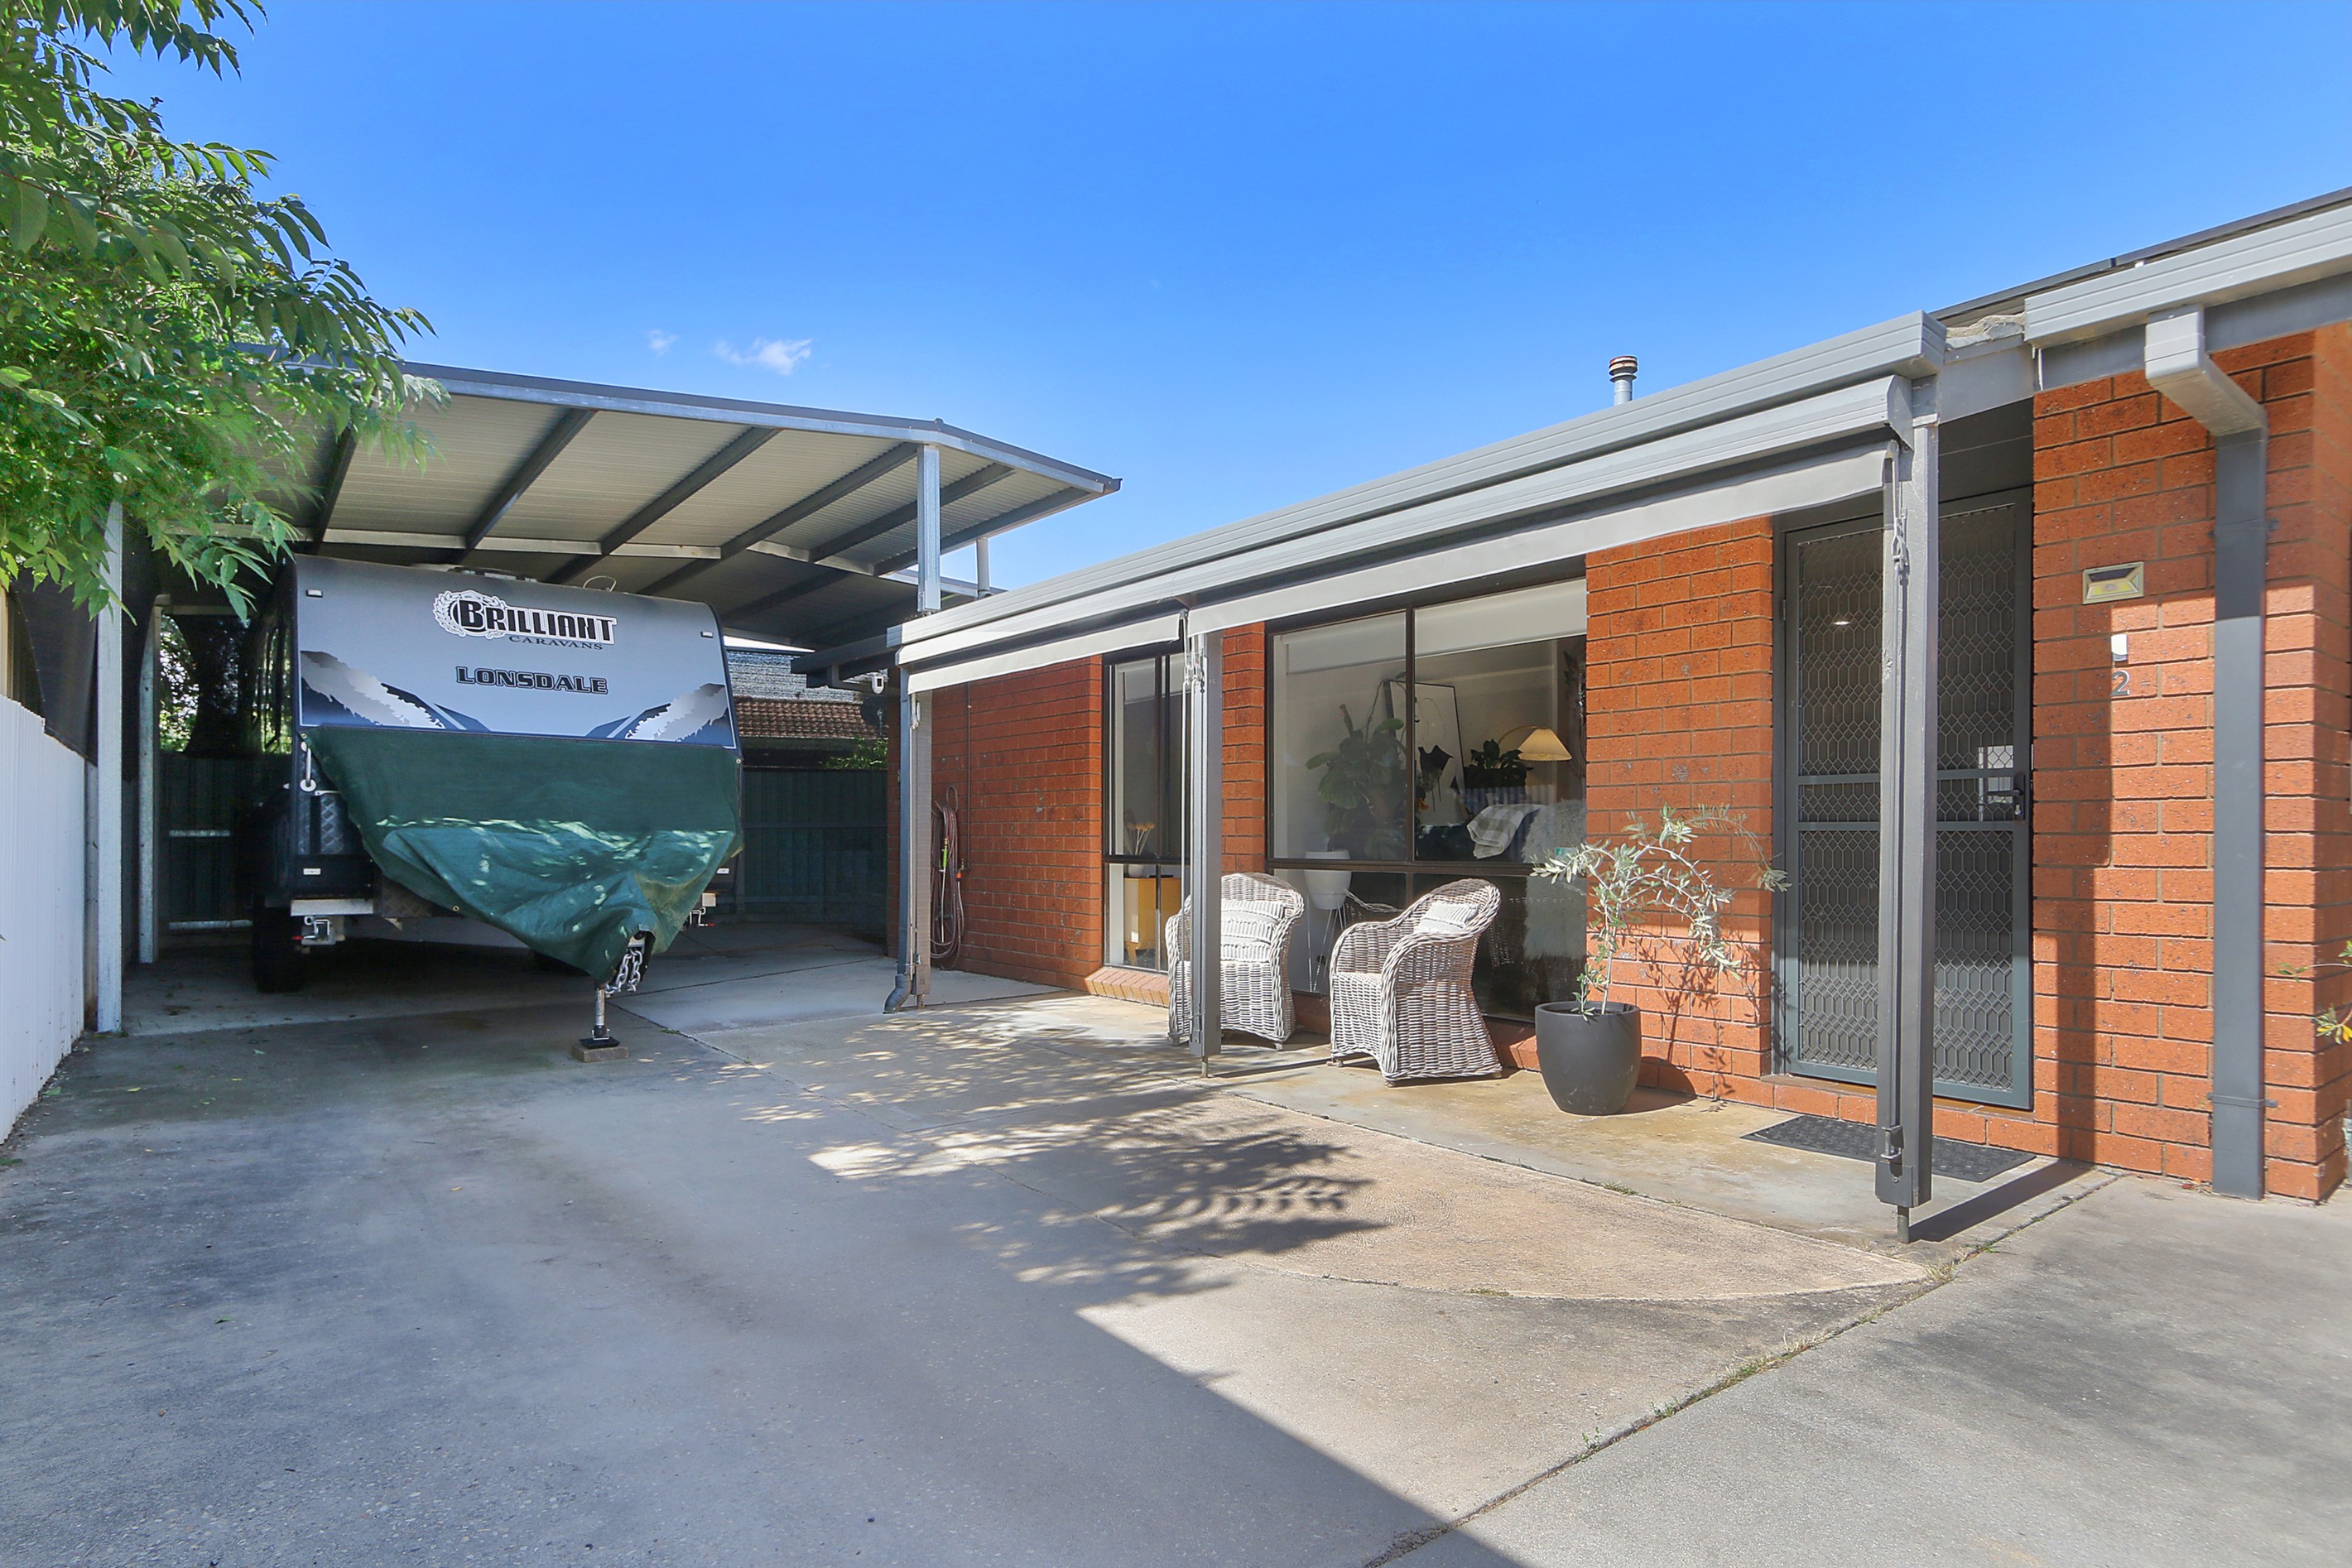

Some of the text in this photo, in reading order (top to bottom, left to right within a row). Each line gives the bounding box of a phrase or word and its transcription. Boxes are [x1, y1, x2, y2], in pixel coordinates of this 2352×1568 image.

[457, 599, 616, 643] BRILLIANT
[509, 636, 603, 651] CARAVANS
[456, 666, 608, 695] LONSDALE
[2110, 670, 2130, 696] 2
